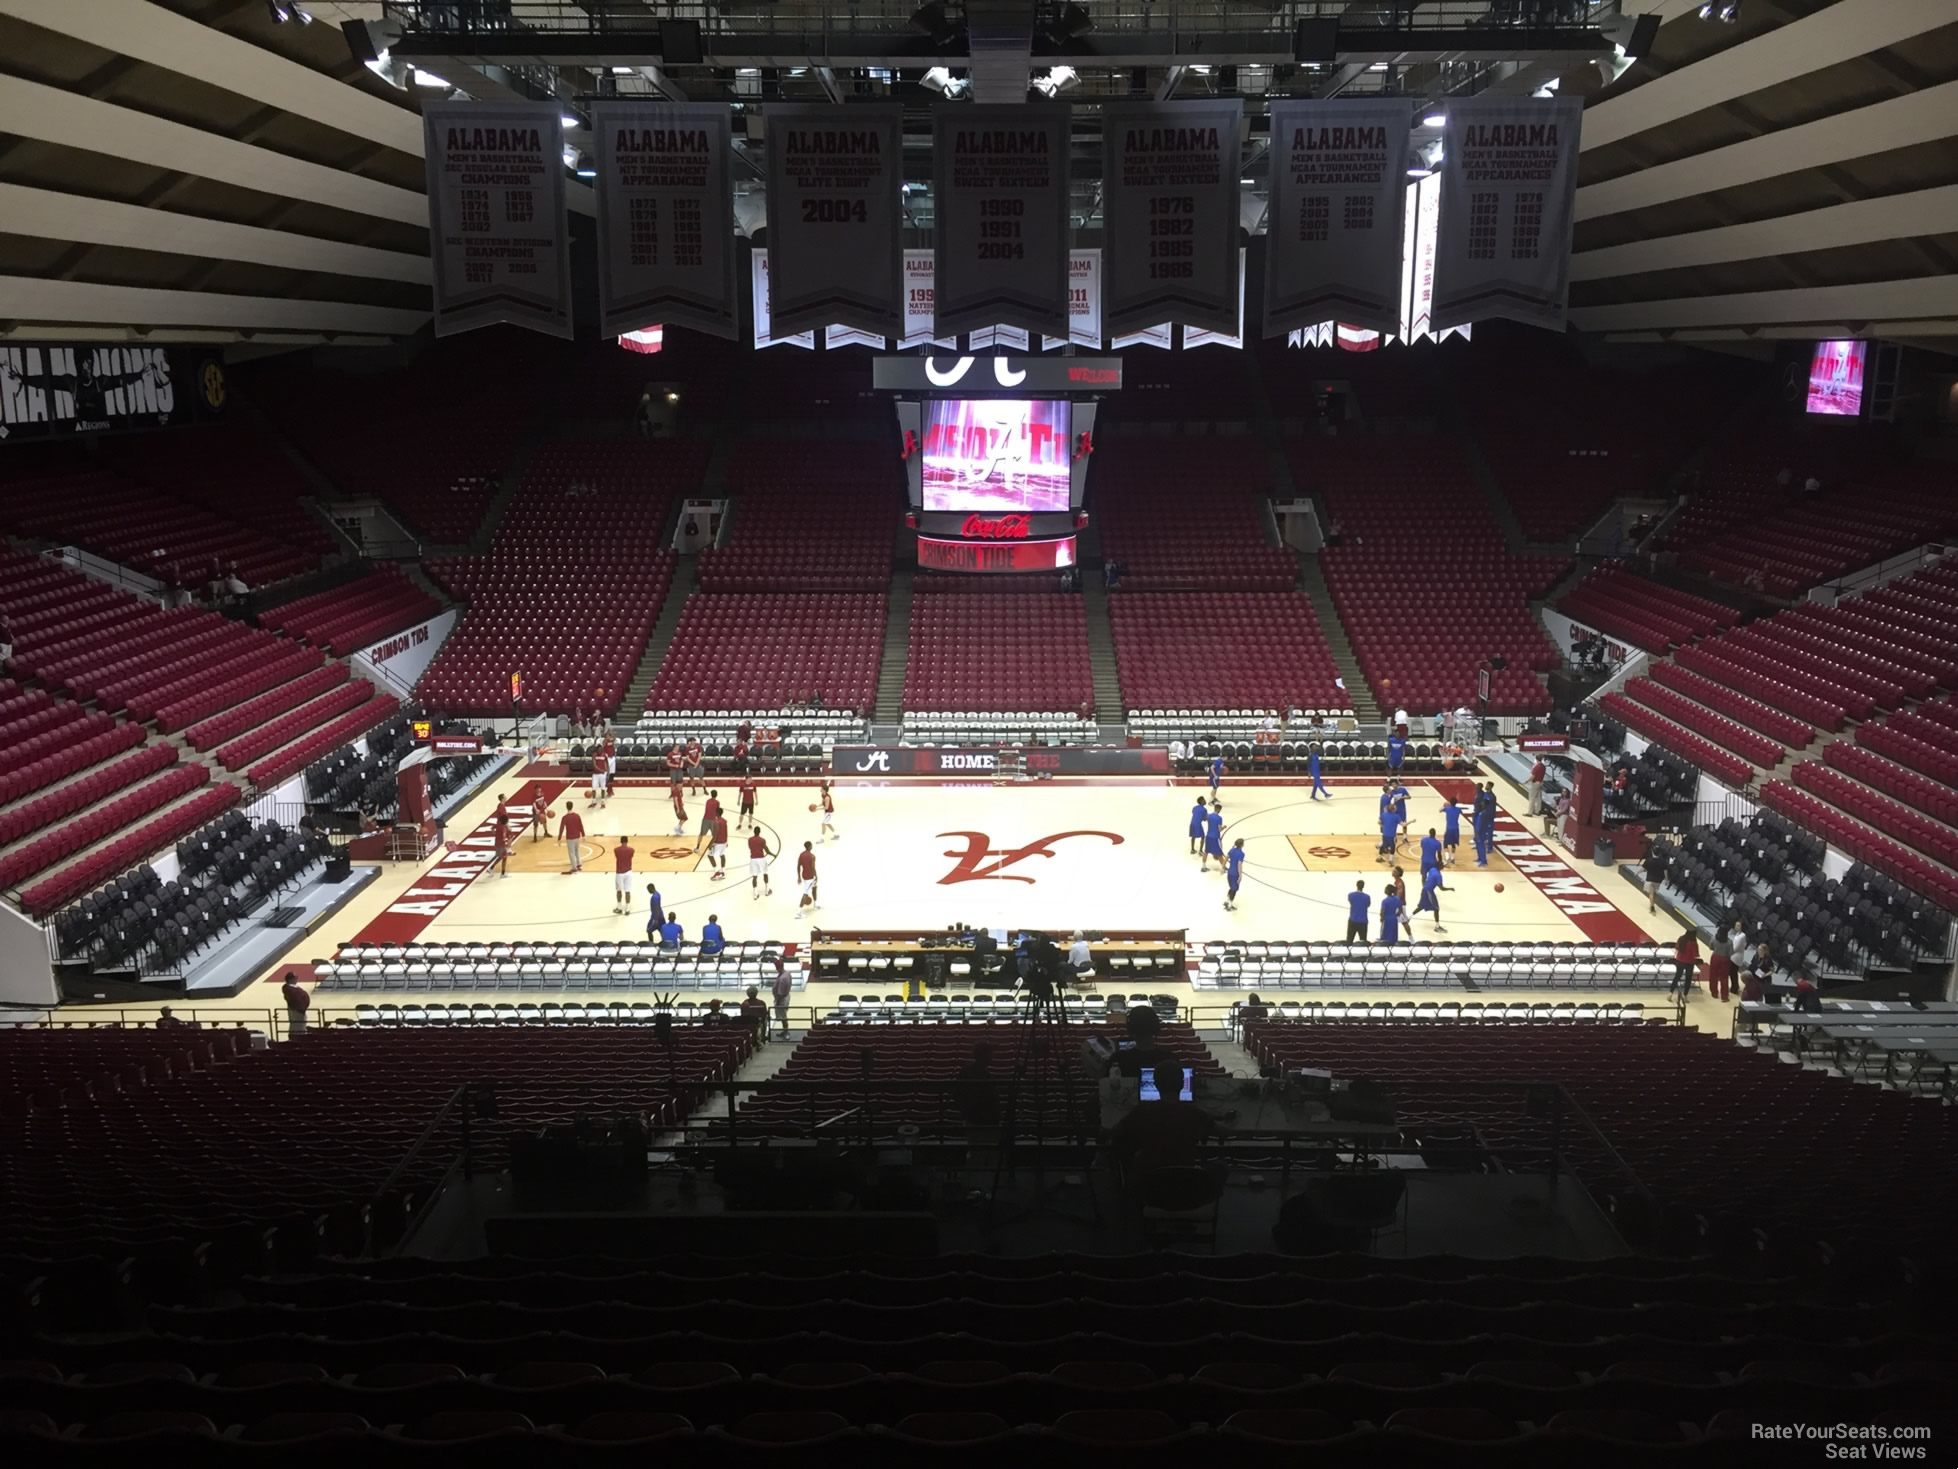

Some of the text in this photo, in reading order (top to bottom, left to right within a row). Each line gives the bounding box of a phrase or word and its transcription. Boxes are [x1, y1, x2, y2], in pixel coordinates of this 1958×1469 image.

[447, 128, 541, 152] ALABAMA
[1125, 128, 1220, 153] ALABAMA
[1292, 126, 1387, 151] ALABAMA
[1463, 124, 1558, 147] ALABAMA
[616, 130, 709, 153] ALABAMA
[787, 131, 881, 154] ALABAMA
[955, 131, 1049, 154] ALABAMA
[479, 154, 543, 164] BASKETBALL
[1156, 154, 1220, 164] BASKETBALL
[1323, 152, 1387, 163] BASKETBALL
[1495, 150, 1558, 159] BASKETBALL
[648, 156, 710, 165] BASKETBALL
[818, 157, 881, 166] BASKETBALL
[987, 157, 1049, 166] BASKETBALL
[1490, 159, 1559, 169] TOURNAMENT
[464, 165, 508, 174] REGULAR
[510, 165, 545, 174] SEASON
[641, 166, 708, 175] TOURNAMENT
[815, 167, 882, 177] TOURNAMENT
[984, 167, 1050, 177] TOURNAMENT
[1151, 164, 1221, 174] TOURNAMENT
[1318, 162, 1387, 172] TOURNAMENT
[461, 174, 530, 185] CHAMPIONS
[622, 175, 706, 186] APPEARANCES
[1122, 174, 1221, 187] SWEET SIXTEEN
[1295, 173, 1381, 184] APPEARANCES
[1466, 170, 1552, 181] APPEARANCES
[798, 177, 870, 188] ELITE EIGHT
[953, 177, 1050, 188] SWEET SIXTEEN
[802, 199, 868, 223] 2004
[979, 199, 1024, 217] 1990
[1149, 196, 1194, 215] 1976
[979, 220, 1021, 238] 1991
[1150, 218, 1194, 236] 1982
[465, 238, 510, 247] WESTERN
[512, 239, 553, 248] DIVISION
[465, 247, 534, 258] CHAMPIONS
[978, 242, 1024, 260] 2004
[1149, 240, 1194, 258] 1985
[1149, 261, 1194, 280] 1986
[962, 514, 1032, 539] Coca-Cola
[922, 542, 1016, 569] CRIMSON TIDE
[371, 625, 429, 666] CRIMSON TIDE
[1607, 640, 1627, 663] TIDE
[941, 754, 994, 769] HOME
